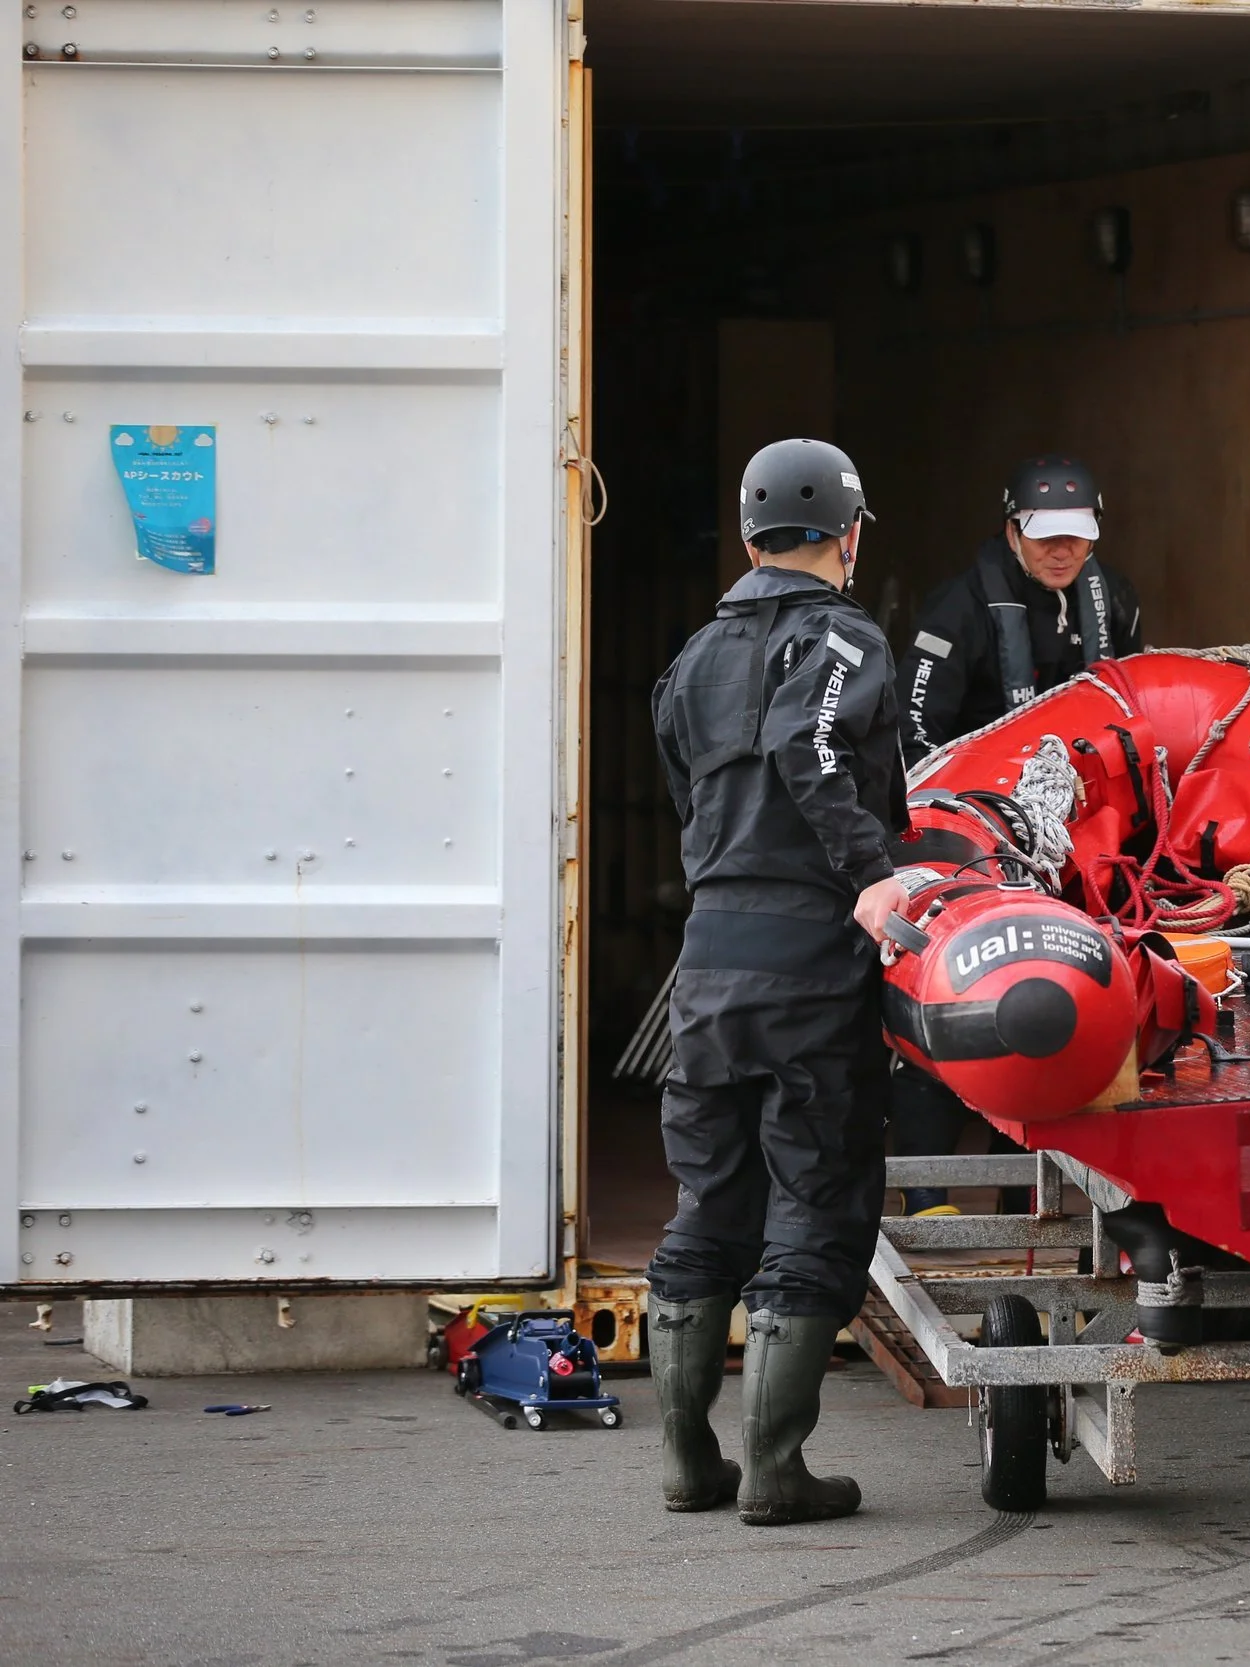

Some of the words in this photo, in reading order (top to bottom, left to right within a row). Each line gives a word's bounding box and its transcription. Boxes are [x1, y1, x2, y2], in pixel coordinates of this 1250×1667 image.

[1088, 575, 1108, 649] HANSEN
[911, 658, 933, 708] HELLY
[1012, 686, 1035, 703] HH
[956, 926, 1034, 976] ual:
[1041, 925, 1101, 950] university
[1042, 933, 1056, 942] of
[1059, 935, 1080, 949] the
[1081, 943, 1104, 961] arts
[1043, 941, 1087, 962] london
